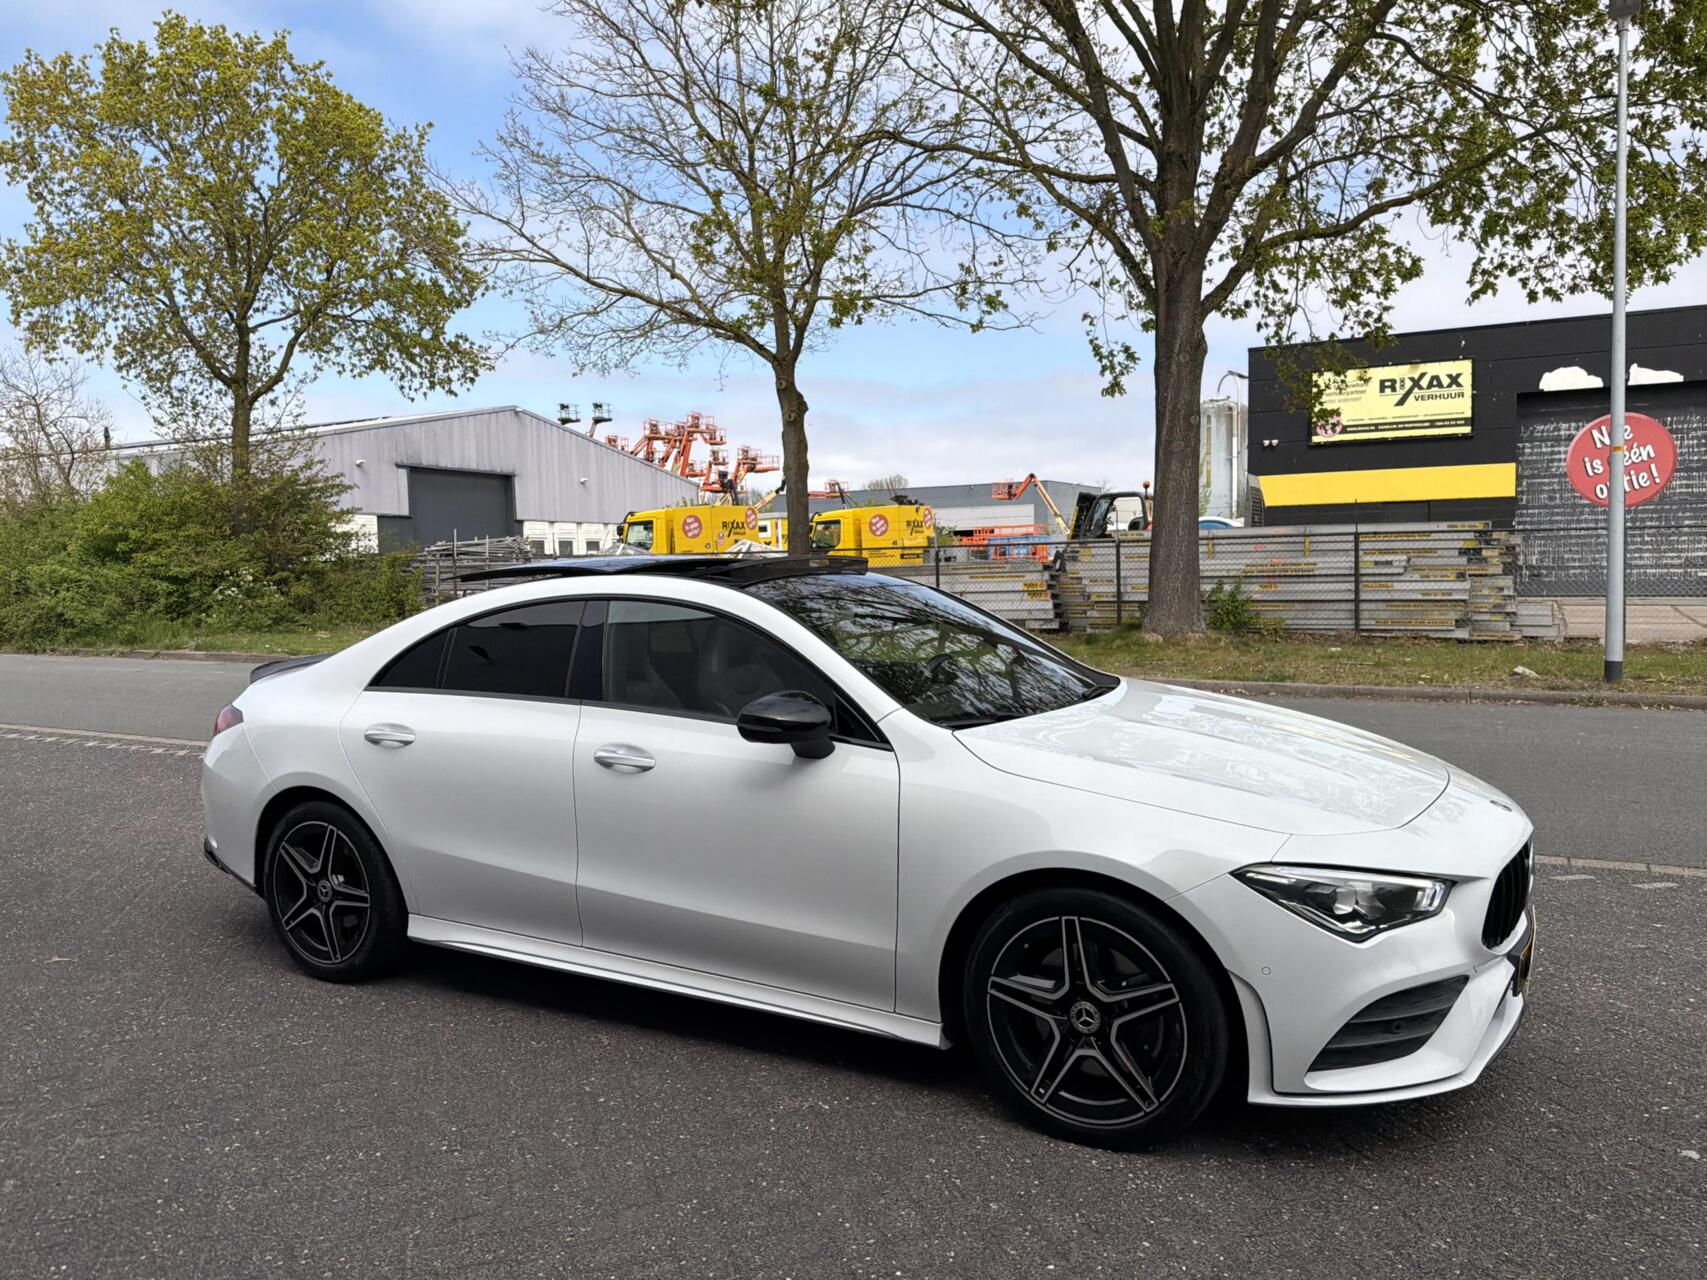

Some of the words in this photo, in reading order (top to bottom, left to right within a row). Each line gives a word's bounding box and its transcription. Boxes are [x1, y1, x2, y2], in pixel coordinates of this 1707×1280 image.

[1379, 372, 1464, 407] RIXAX
[1414, 391, 1465, 402] VERHUUR
[1591, 425, 1633, 448] Ne
[1584, 457, 1604, 476] is
